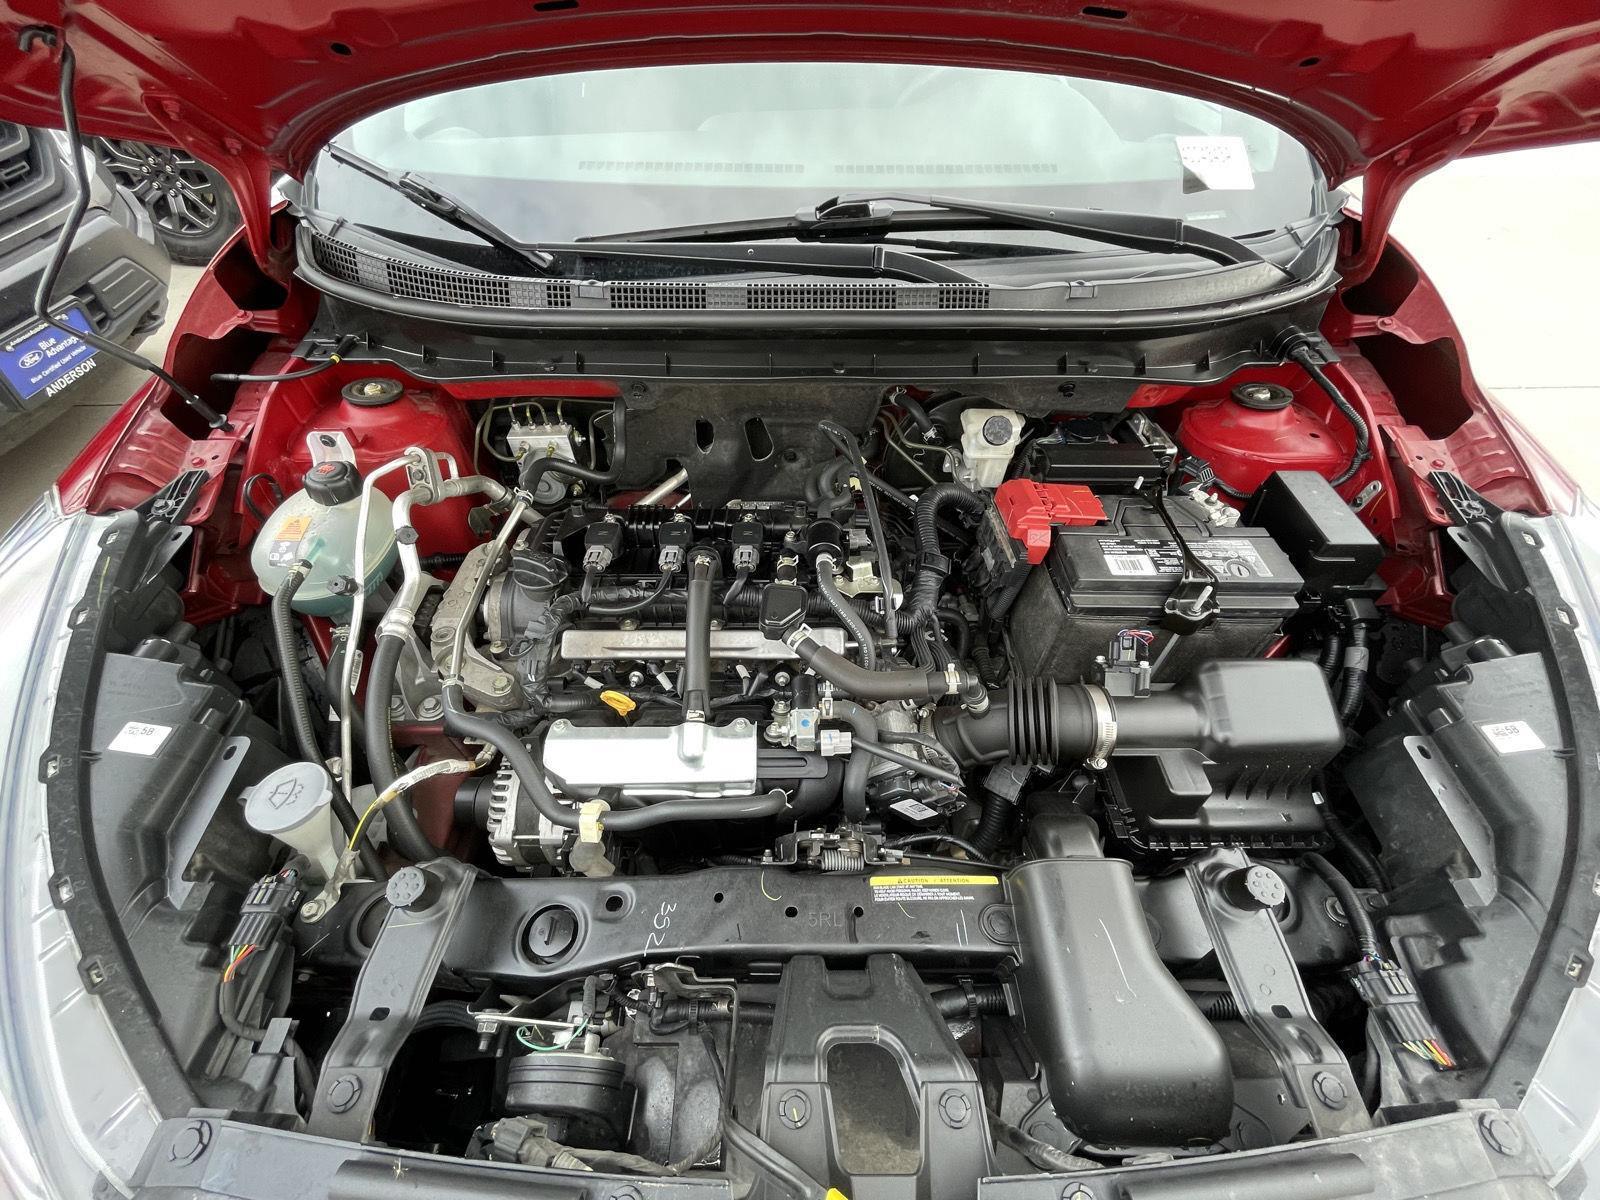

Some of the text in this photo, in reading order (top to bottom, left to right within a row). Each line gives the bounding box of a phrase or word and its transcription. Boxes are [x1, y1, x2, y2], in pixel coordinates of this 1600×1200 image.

[38, 337, 57, 351] Blue
[45, 335, 80, 358] Advantag
[30, 374, 43, 384] Blue
[45, 358, 97, 397] ANDERSON
